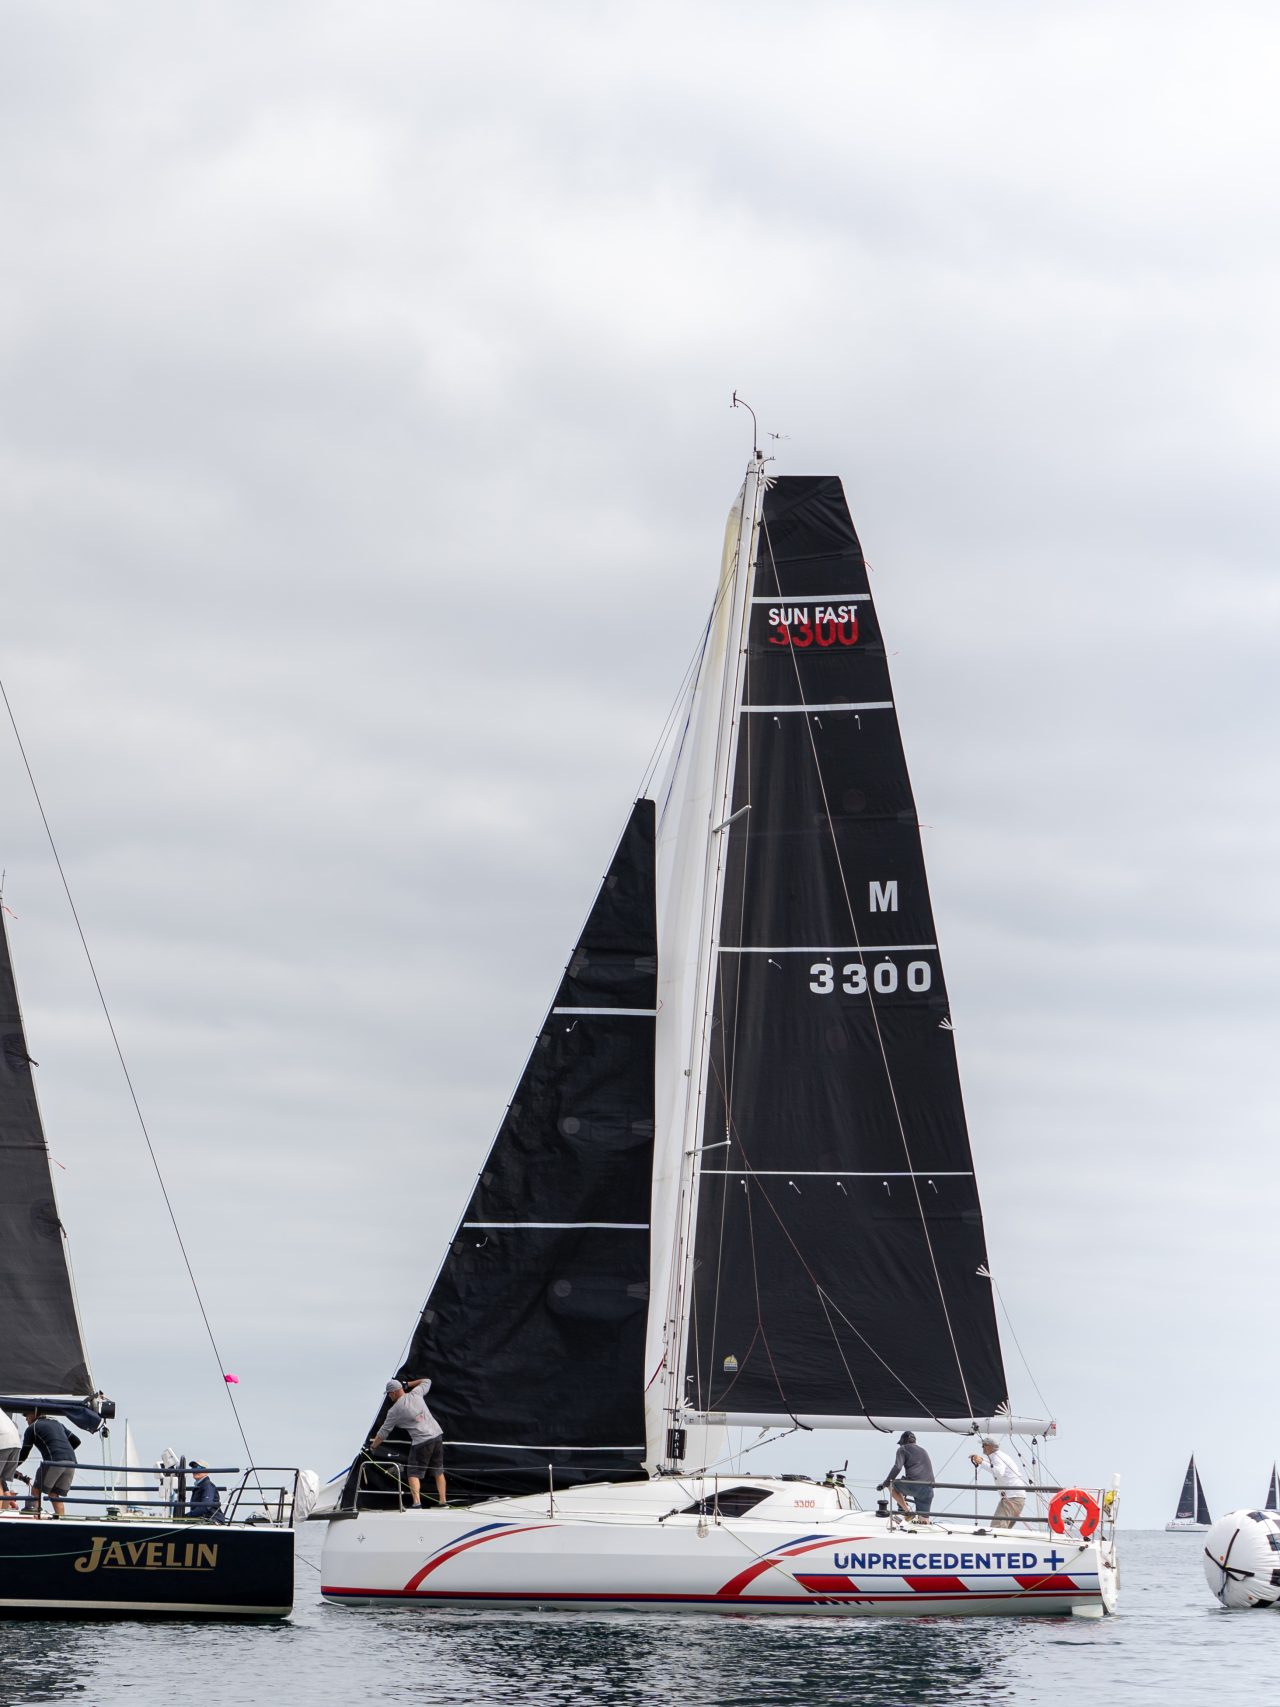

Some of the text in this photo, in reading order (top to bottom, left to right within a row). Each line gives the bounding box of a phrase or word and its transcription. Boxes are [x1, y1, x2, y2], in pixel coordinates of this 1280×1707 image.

[768, 605, 858, 626] SUN FAST
[869, 880, 898, 912] M
[809, 960, 932, 995] 3300
[793, 1499, 816, 1508] 3300
[74, 1536, 218, 1573] JAVELIN
[834, 1551, 1038, 1570] UNPRECEDENTED
